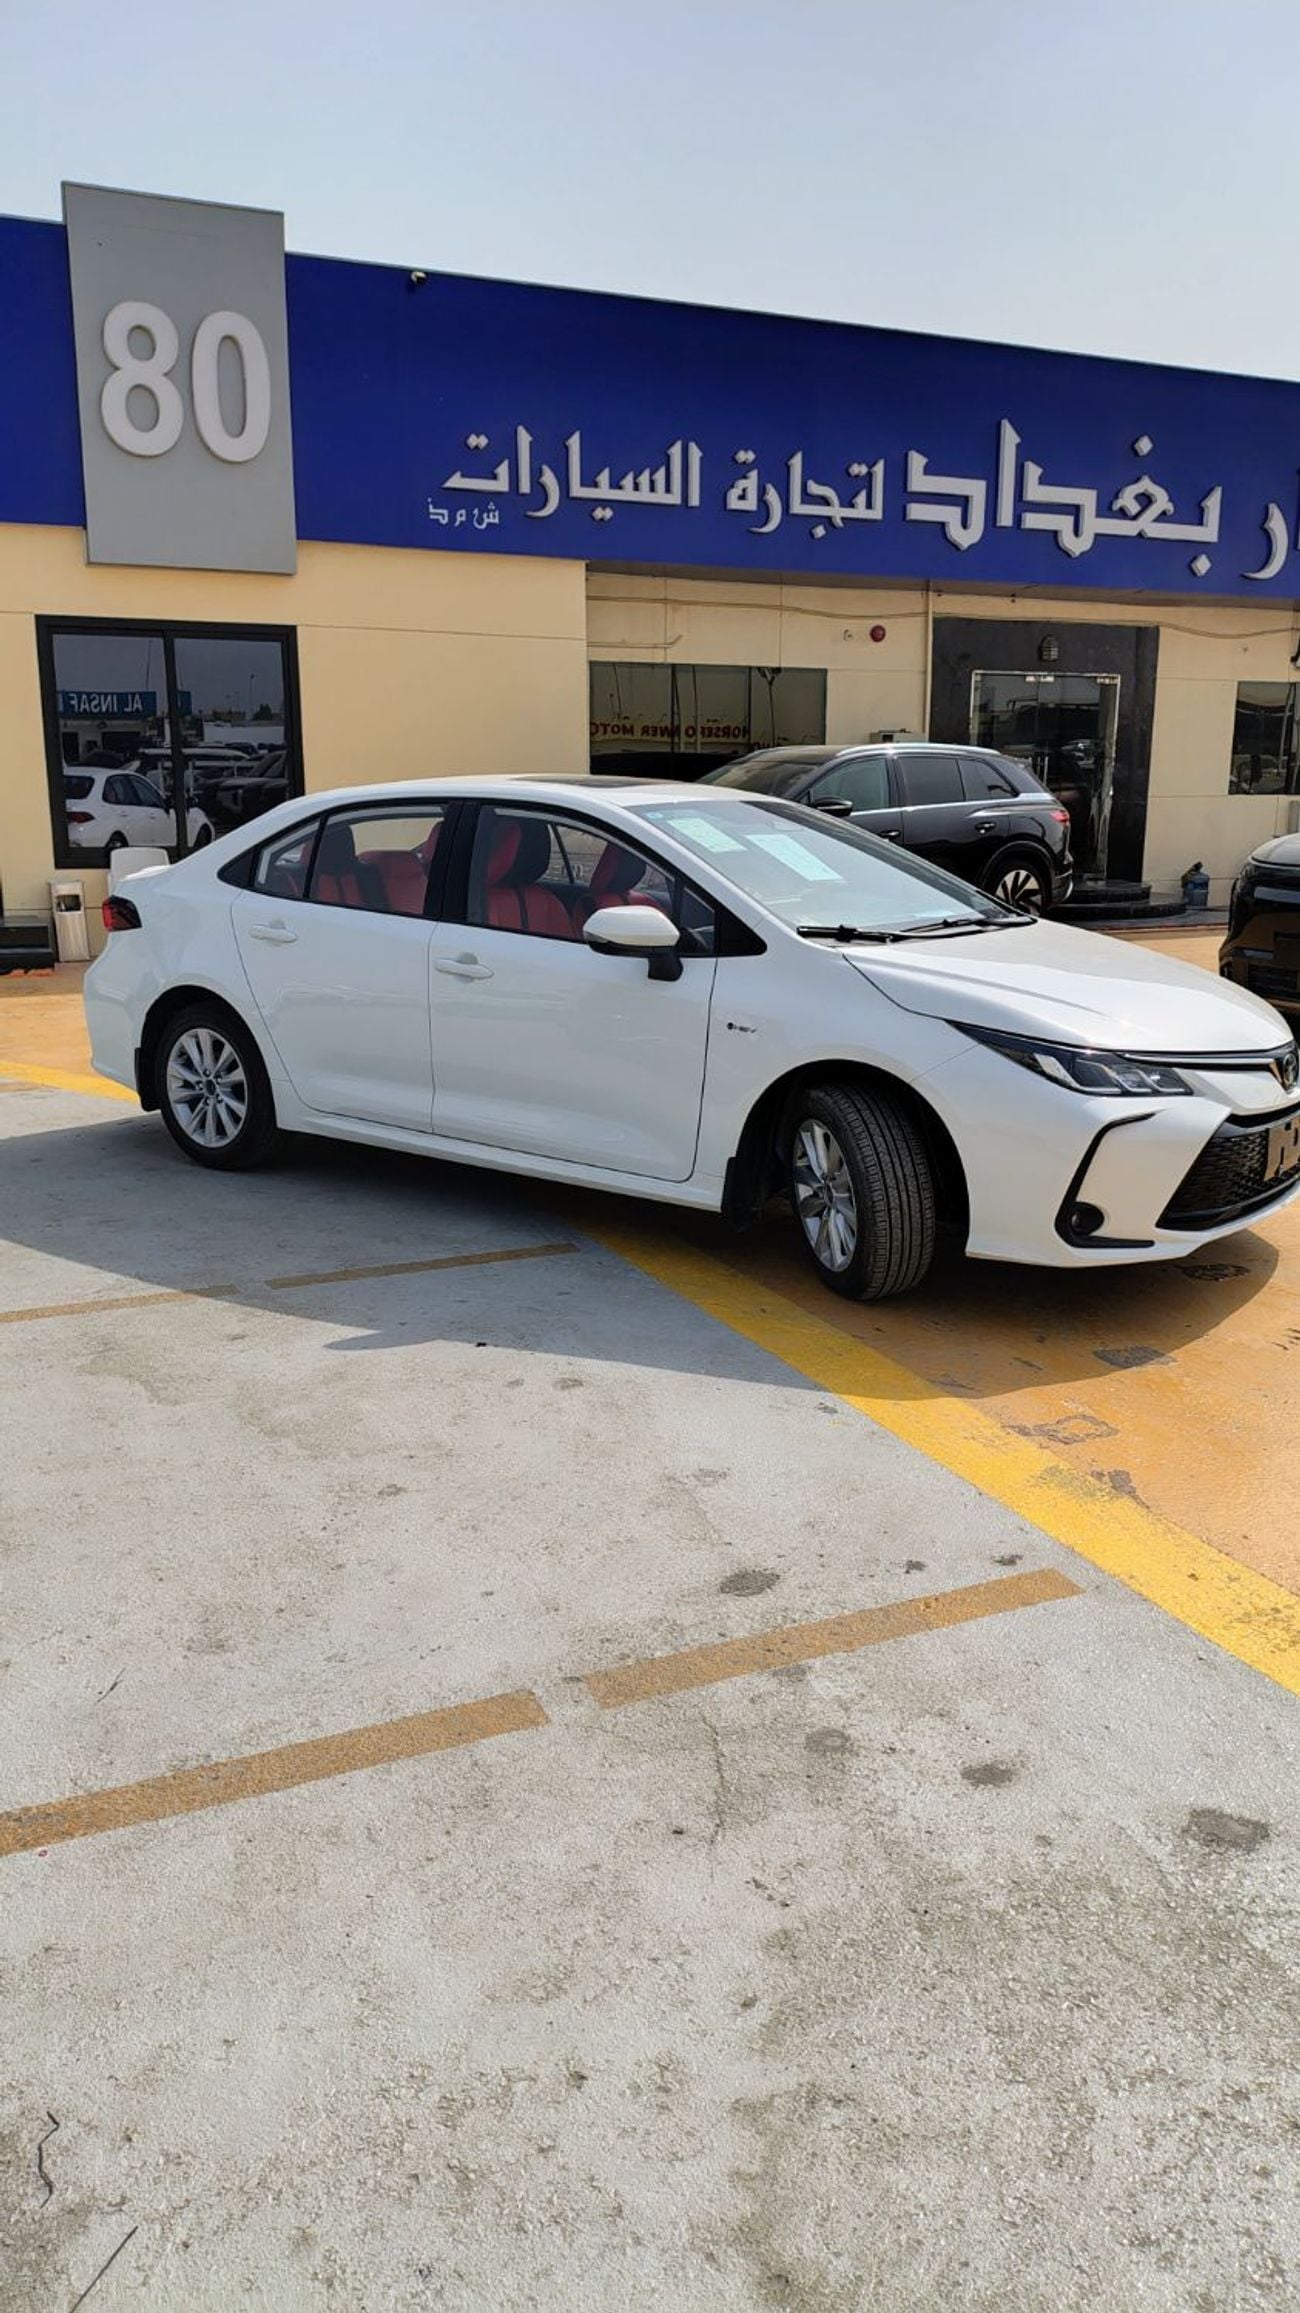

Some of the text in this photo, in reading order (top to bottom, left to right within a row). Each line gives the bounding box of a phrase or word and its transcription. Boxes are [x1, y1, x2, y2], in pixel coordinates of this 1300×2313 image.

[101, 301, 271, 463] 80
[442, 425, 703, 521] السيارات
[726, 450, 885, 539] لتجارة
[906, 418, 1222, 577] بغداد
